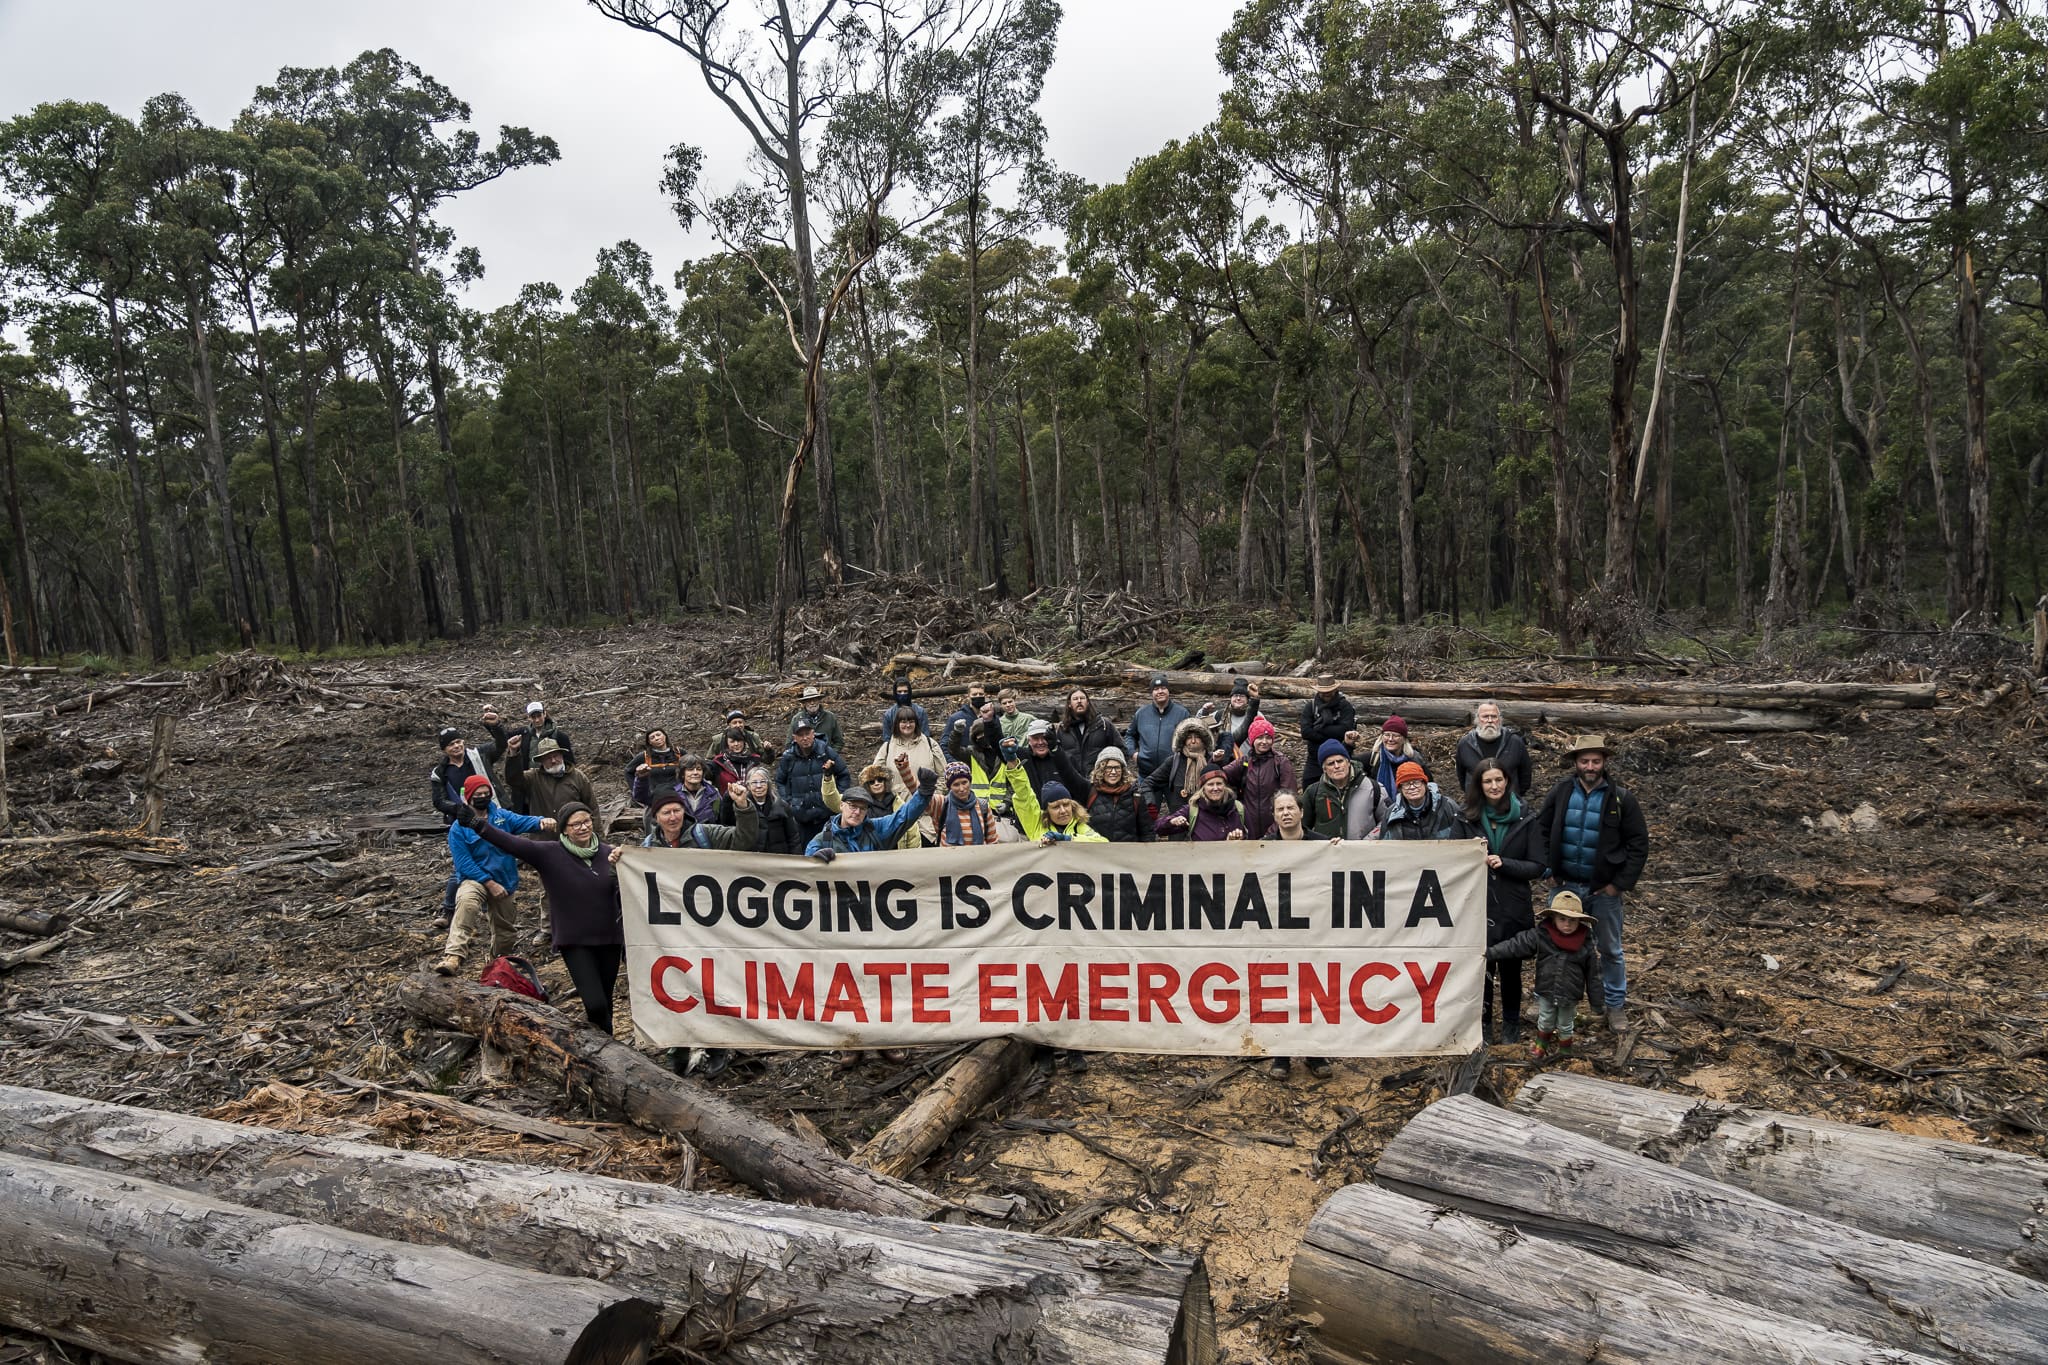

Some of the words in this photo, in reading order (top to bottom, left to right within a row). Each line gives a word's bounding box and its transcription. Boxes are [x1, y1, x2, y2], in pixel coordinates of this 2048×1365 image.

[644, 872, 918, 932] LOGGING
[939, 875, 992, 930] IS
[1012, 872, 1310, 931] CRIMINAL
[1331, 870, 1386, 929] IN
[1404, 869, 1454, 928] A
[651, 956, 951, 1023] CLIMATE
[978, 961, 1451, 1025] EMERGENCY
